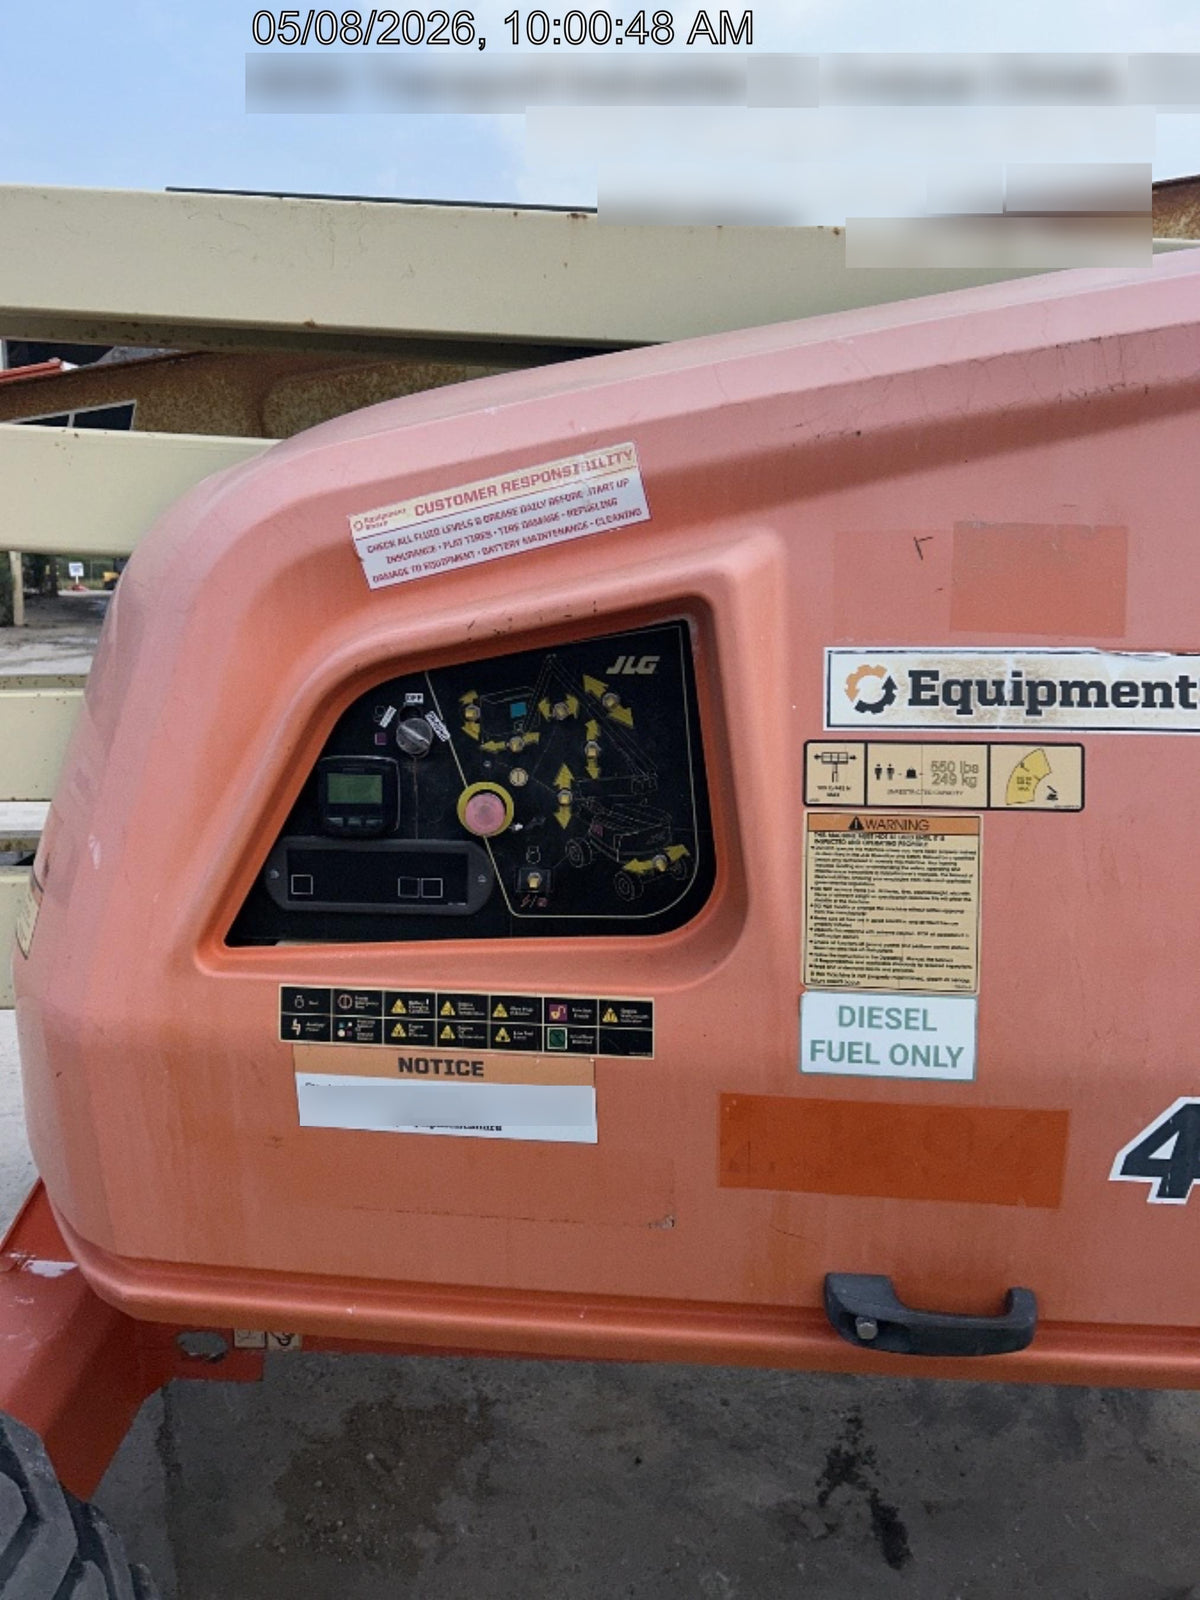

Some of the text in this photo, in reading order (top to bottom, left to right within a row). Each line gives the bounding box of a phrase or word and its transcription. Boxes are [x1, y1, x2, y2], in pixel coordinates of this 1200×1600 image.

[414, 484, 498, 517] CUSTOMER
[520, 499, 547, 514] DAILY
[616, 477, 630, 489] UP
[606, 655, 661, 675] JLG
[908, 669, 1197, 716] Equipment
[960, 760, 980, 774] lbs
[961, 773, 978, 789] kg
[864, 818, 930, 831] WARNING
[838, 1005, 938, 1031] DIESEL
[810, 1039, 965, 1068] FUEL ONLY
[397, 1057, 485, 1077] NOTICE
